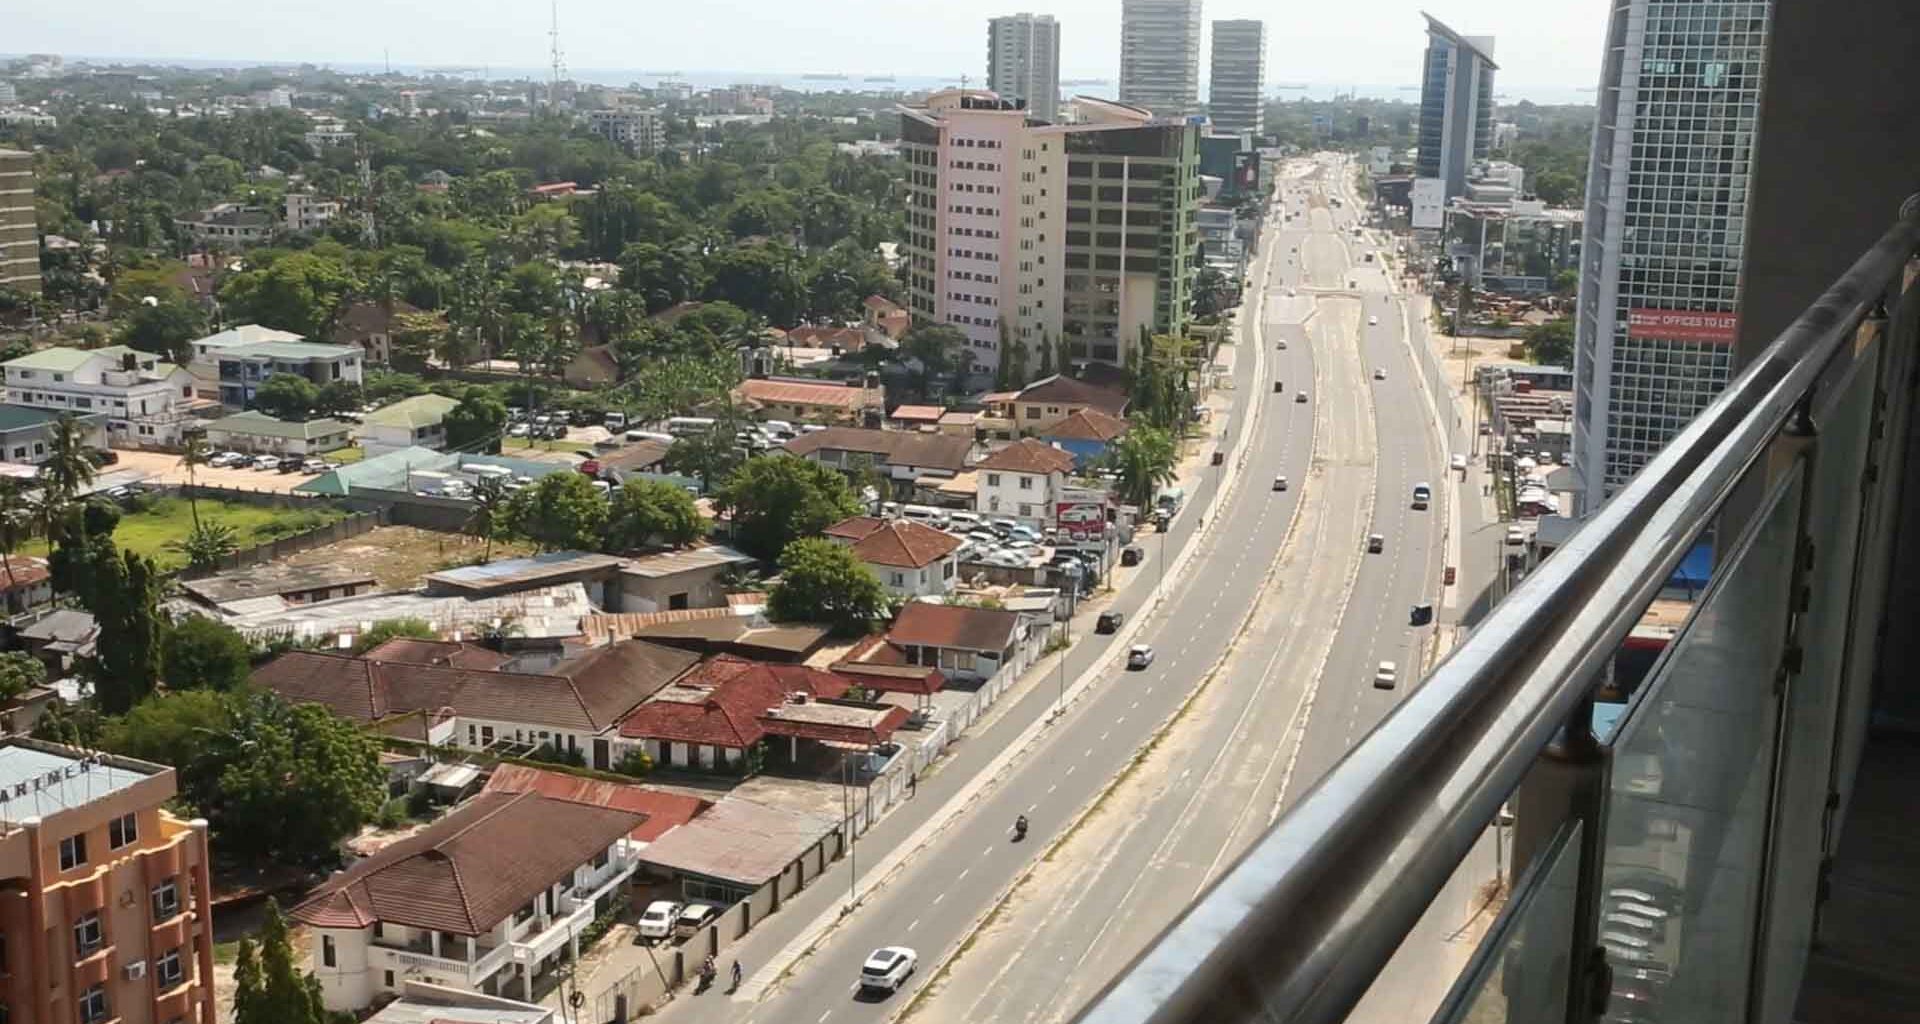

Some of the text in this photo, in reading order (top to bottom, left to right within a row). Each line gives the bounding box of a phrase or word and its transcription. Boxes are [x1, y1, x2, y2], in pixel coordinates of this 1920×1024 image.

[1663, 315, 1702, 327] OFFICES
[1704, 317, 1718, 328] TO
[1719, 318, 1737, 329] LET
